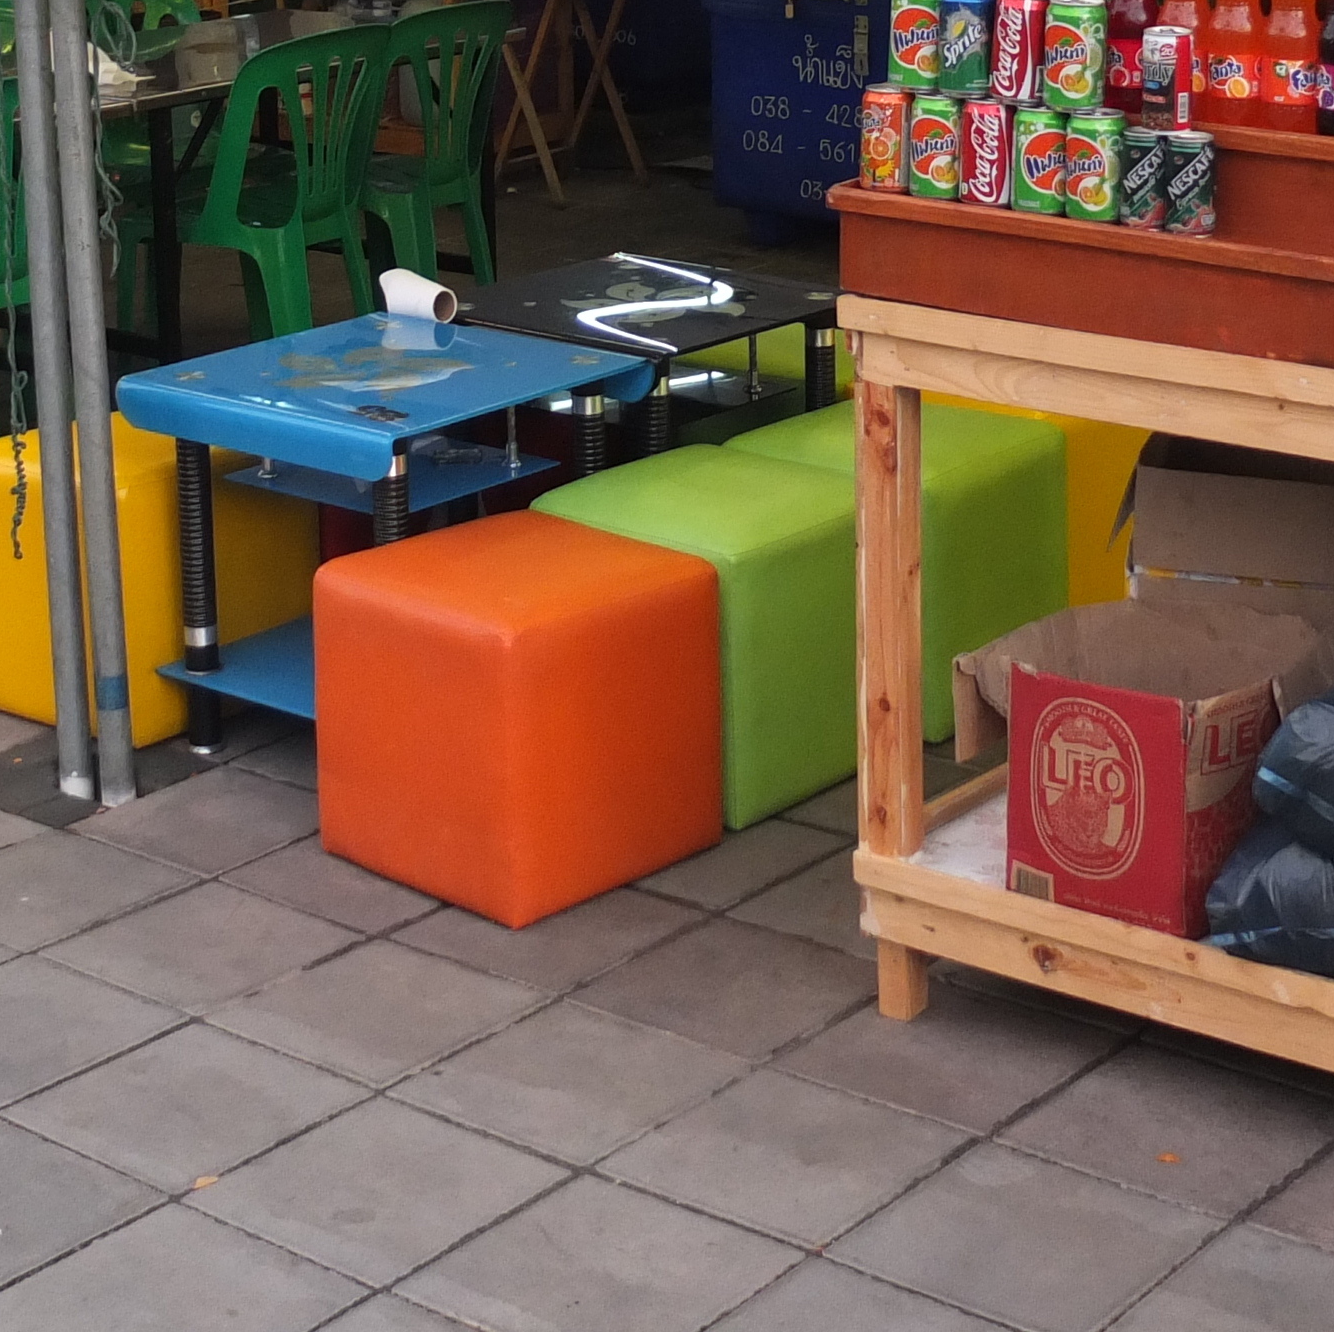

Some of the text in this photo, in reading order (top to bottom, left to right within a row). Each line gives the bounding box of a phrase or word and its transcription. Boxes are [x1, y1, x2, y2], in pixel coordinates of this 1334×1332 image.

[943, 22, 983, 69] Sprite
[991, 3, 1023, 98] Coca-Cola
[751, 96, 790, 119] 038
[742, 130, 783, 154] 084
[820, 139, 855, 162] 561
[968, 106, 1001, 204] Coca-Cola
[1042, 741, 1135, 804] LEO
[1200, 708, 1259, 776] LE
